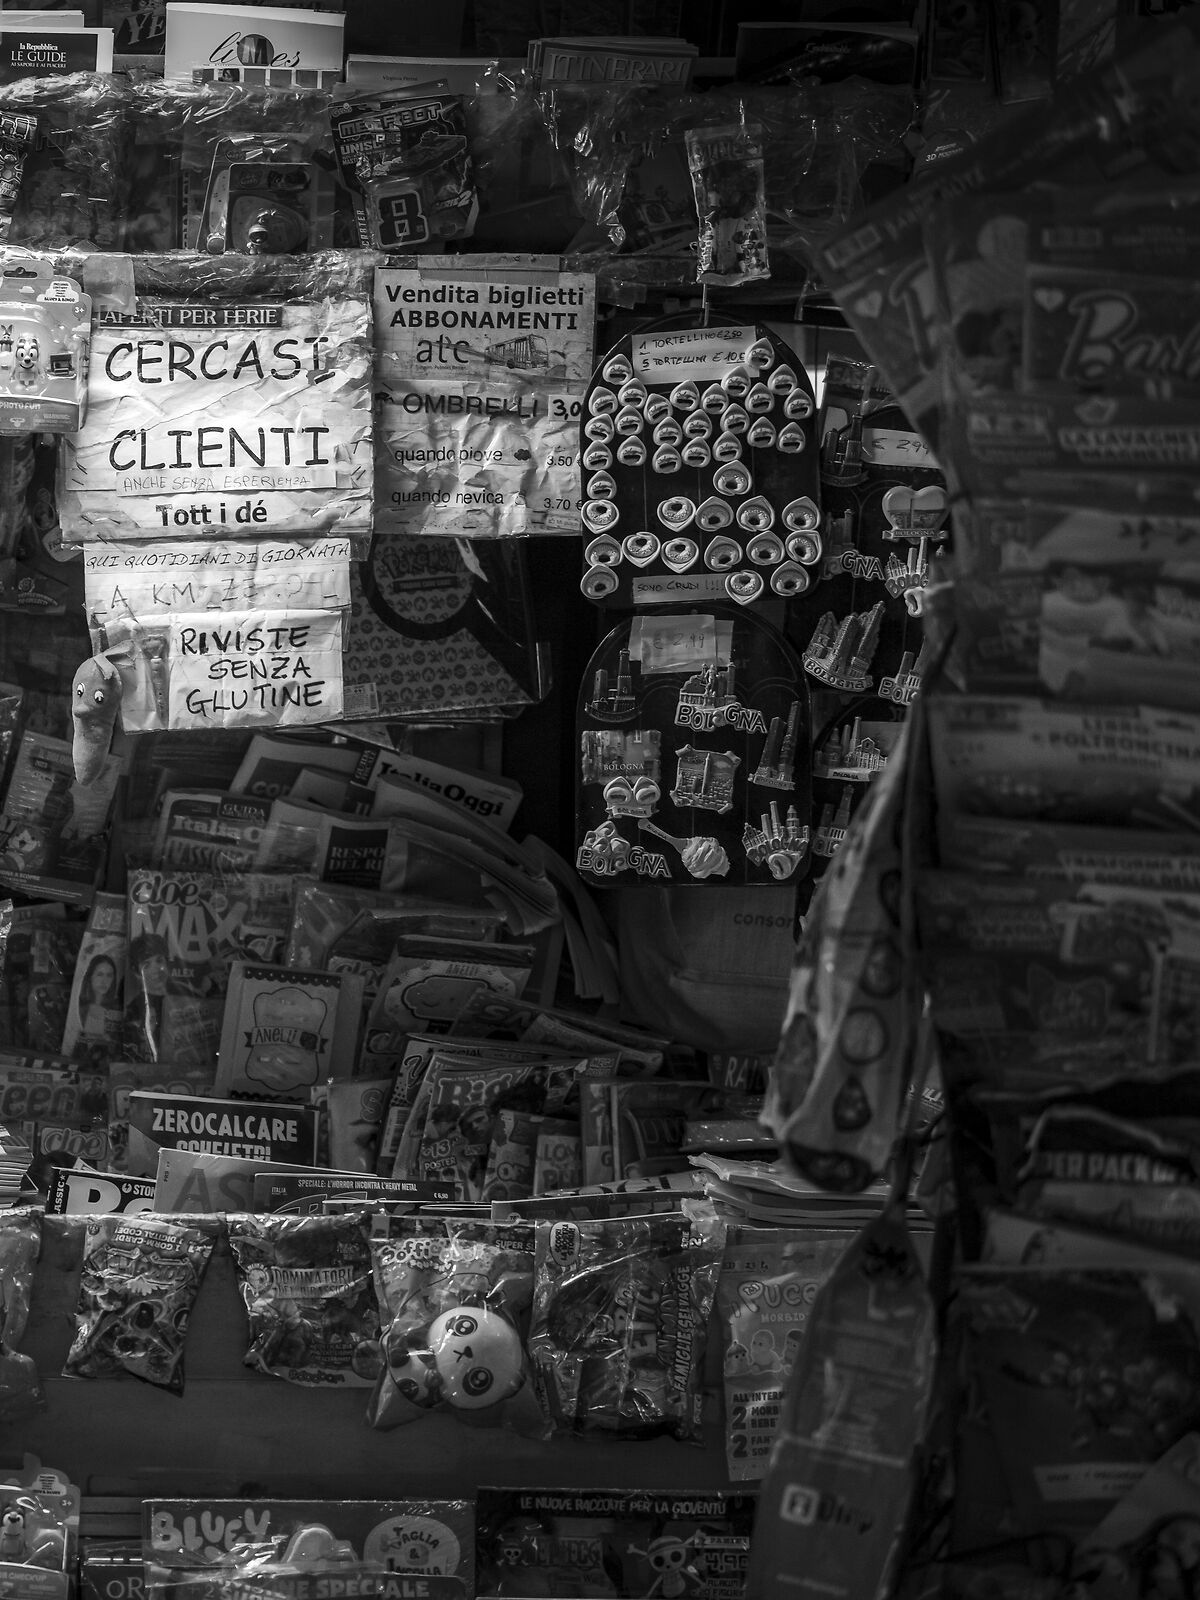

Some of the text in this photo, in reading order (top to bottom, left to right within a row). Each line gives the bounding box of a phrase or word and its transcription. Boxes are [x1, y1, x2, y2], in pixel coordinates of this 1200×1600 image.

[11, 51, 67, 63] LE GUIDE
[27, 42, 59, 51] Repubblica
[549, 54, 689, 81] ITINERARI
[385, 285, 585, 308] Vendita biglietti
[179, 308, 278, 325] PER FERIE
[390, 310, 578, 330] ABBONAMENTI
[639, 333, 717, 354] 1 TORTELLINO
[104, 336, 330, 384] CERCASI
[642, 358, 651, 371] 5
[402, 392, 538, 418] OMBRELLI
[109, 426, 330, 471] CLIENTI
[394, 445, 574, 467] quando piove 3.50
[122, 475, 311, 492] ANCHE SENZA ESPERIENZA
[391, 489, 572, 510] quando nevica 3.70
[156, 504, 212, 527] Tott
[234, 499, 268, 523] dé
[86, 542, 349, 569] QUI QUOTIDIANI DI GIORNATA
[637, 579, 699, 592] SONO CRUDI
[180, 625, 310, 655] RIVISTE
[208, 657, 311, 681] SENZA
[185, 680, 325, 717] GLUTINE
[603, 762, 645, 772] BOLOGNA
[171, 967, 195, 978] ALEX
[152, 1107, 298, 1142] ZEROCALCARE
[424, 1156, 457, 1171] POSTER
[1088, 1152, 1152, 1182] PACK
[271, 1186, 287, 1195] ITALIA
[297, 1180, 326, 1188] SPECIALE:
[353, 1181, 379, 1190] INCONTRA
[402, 1183, 418, 1192] METAL
[495, 1239, 524, 1250] SUPER
[274, 1268, 352, 1284] DOMINATORI
[673, 1265, 692, 1392] FAMIGLIE SELVAGGE
[732, 1406, 748, 1430] 2
[732, 1434, 748, 1458] 2
[520, 1496, 669, 1514] LE NUOVE PER LA
[151, 1507, 271, 1552] BLUEY
[393, 1527, 439, 1549] TAGLIA
[409, 1548, 419, 1560] &
[312, 1579, 429, 1600] SPECIALE
